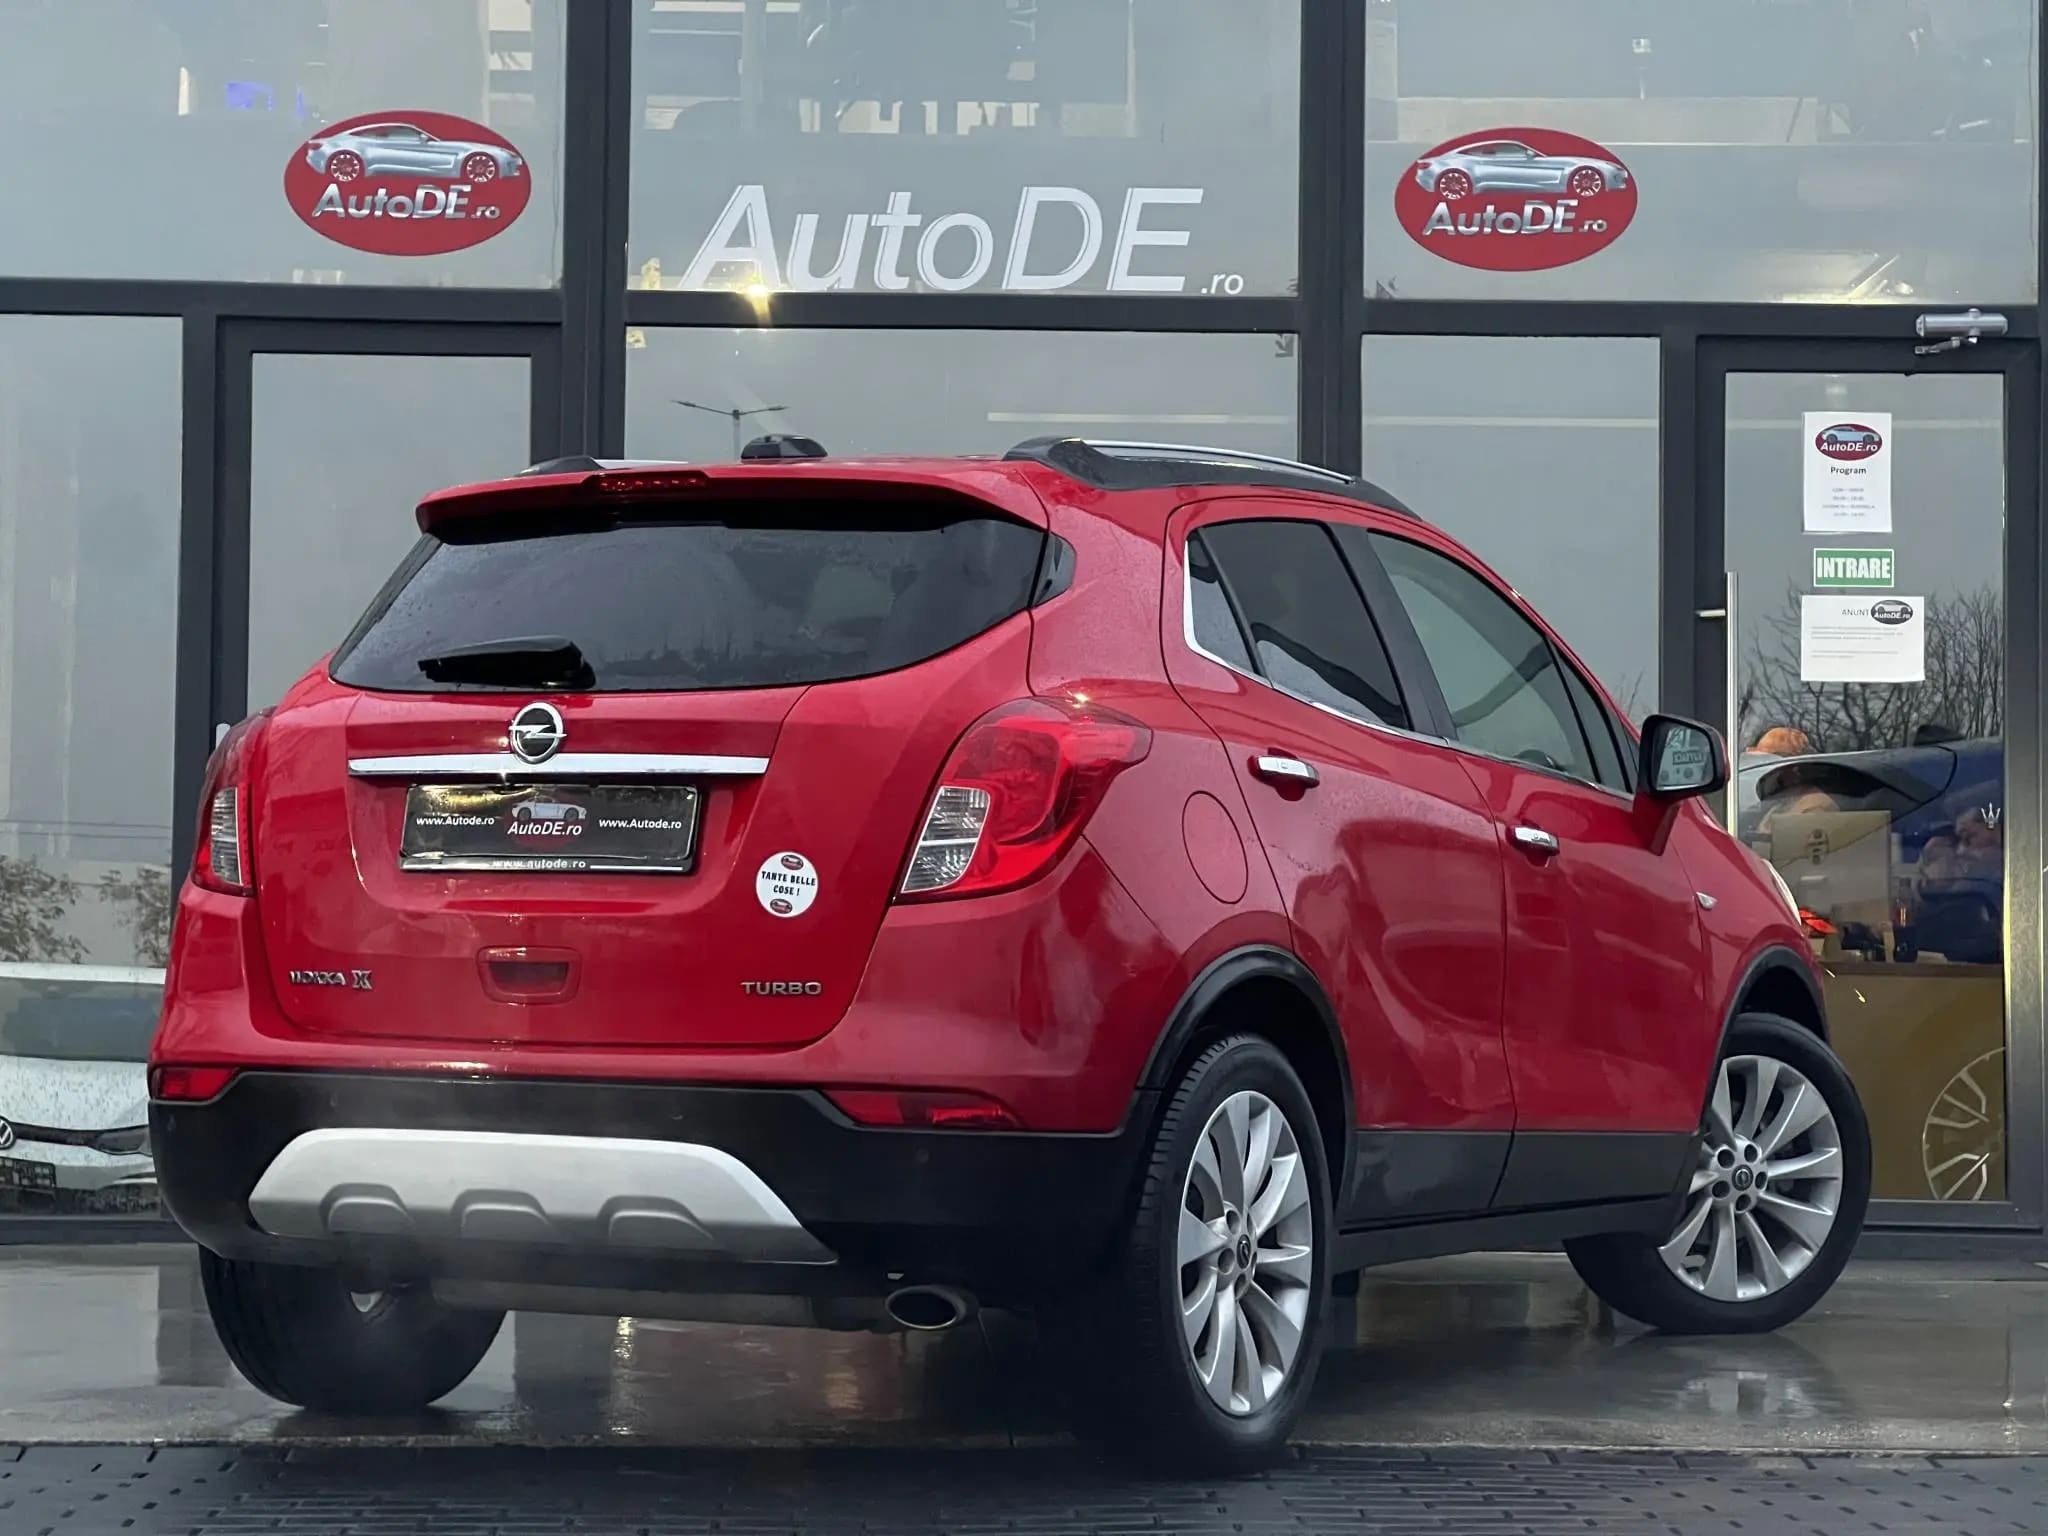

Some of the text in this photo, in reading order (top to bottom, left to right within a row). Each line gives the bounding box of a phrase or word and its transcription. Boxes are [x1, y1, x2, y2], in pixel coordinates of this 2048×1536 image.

[1820, 442, 1878, 452] AutoDE.ro
[1830, 466, 1867, 476] Program
[1816, 557, 1891, 578] INTRARE
[416, 816, 495, 827] www.Autode.ro
[598, 818, 682, 830] www.Autode.ro
[507, 821, 583, 836] AutoDE.ro
[761, 870, 816, 887] TANTE BELLE
[773, 884, 795, 896] COSE
[351, 969, 372, 990] X
[740, 981, 822, 995] TURBO
